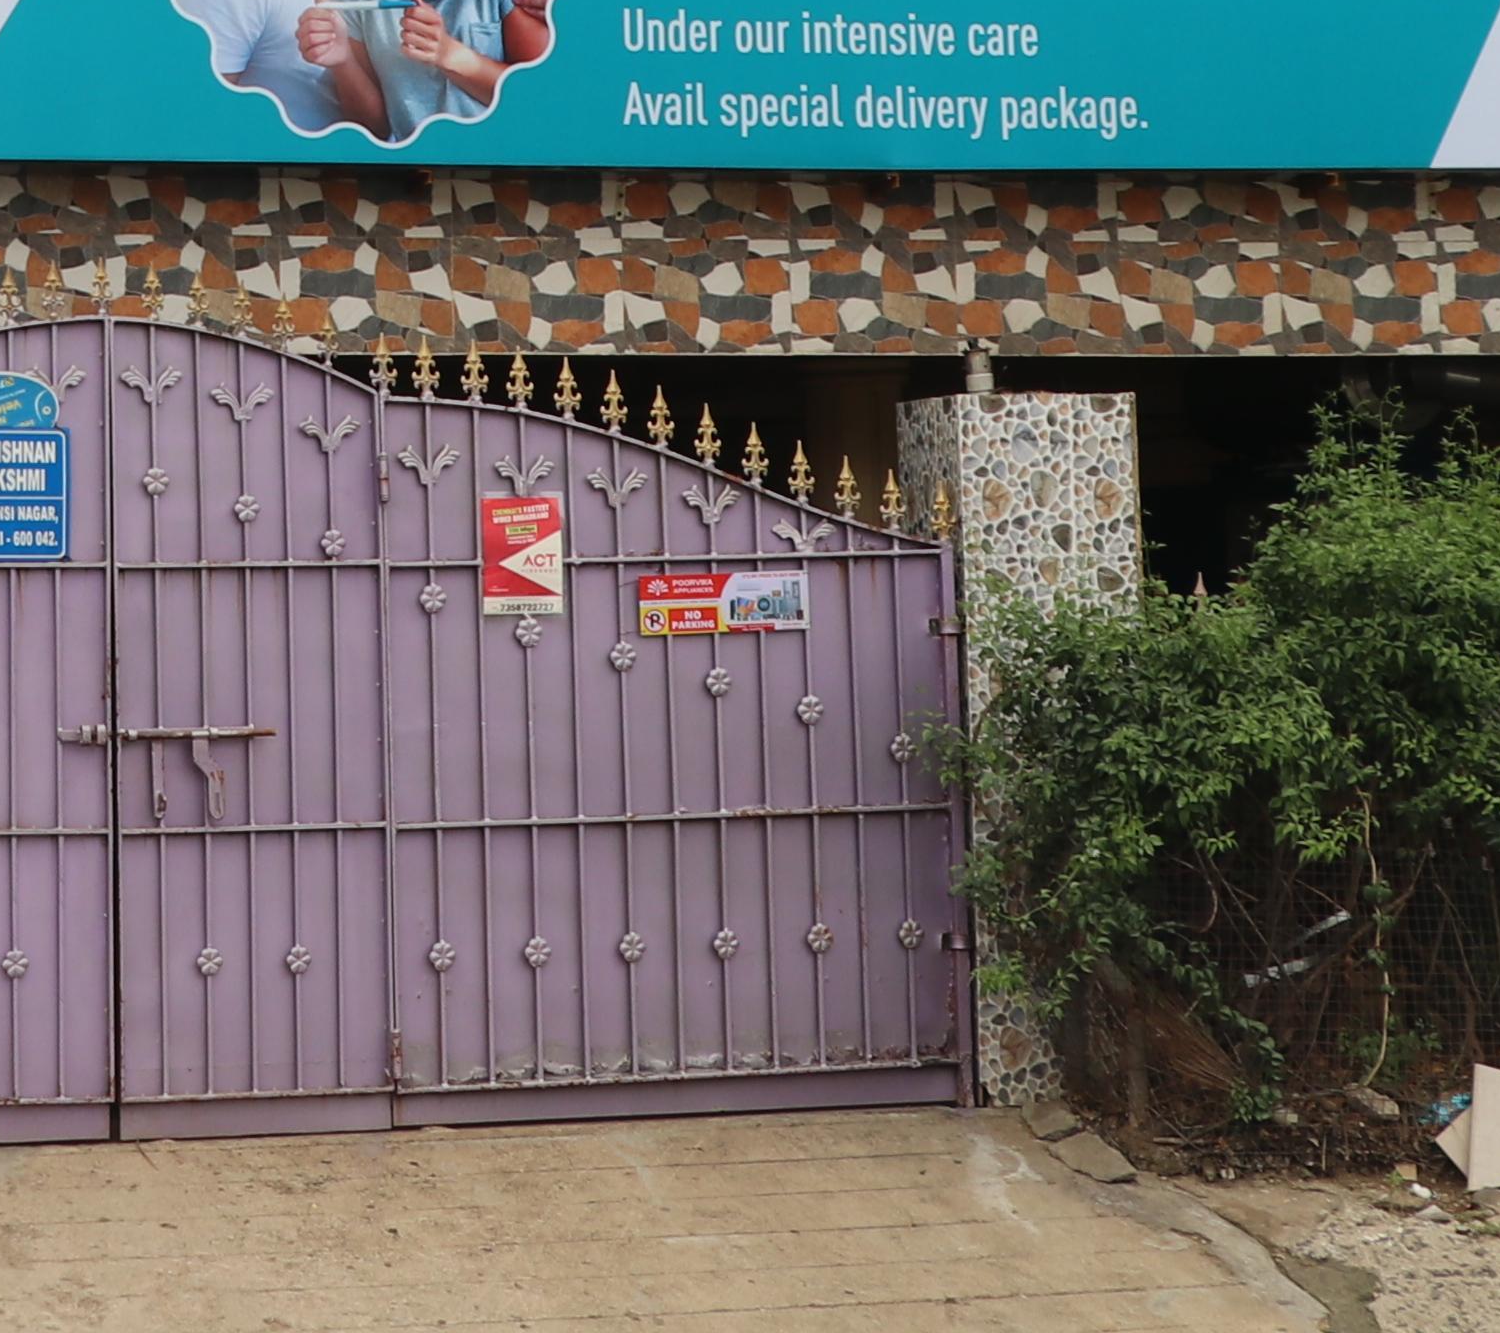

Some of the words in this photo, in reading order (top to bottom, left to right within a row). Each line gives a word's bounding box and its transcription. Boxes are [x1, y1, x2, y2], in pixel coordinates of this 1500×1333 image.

[622, 8, 722, 54] Under
[734, 17, 790, 55] our
[801, 11, 955, 57] intensive
[967, 21, 1039, 58] care
[623, 82, 708, 129] Avail
[718, 83, 844, 135] special
[855, 85, 988, 140] delivery
[1000, 87, 1150, 141] package.
[18, 505, 59, 523] NAGAR,
[13, 531, 32, 546] 600
[35, 531, 58, 546] 042.
[523, 554, 557, 567] ACT
[684, 611, 702, 619] NO
[672, 619, 715, 630] PARKING
